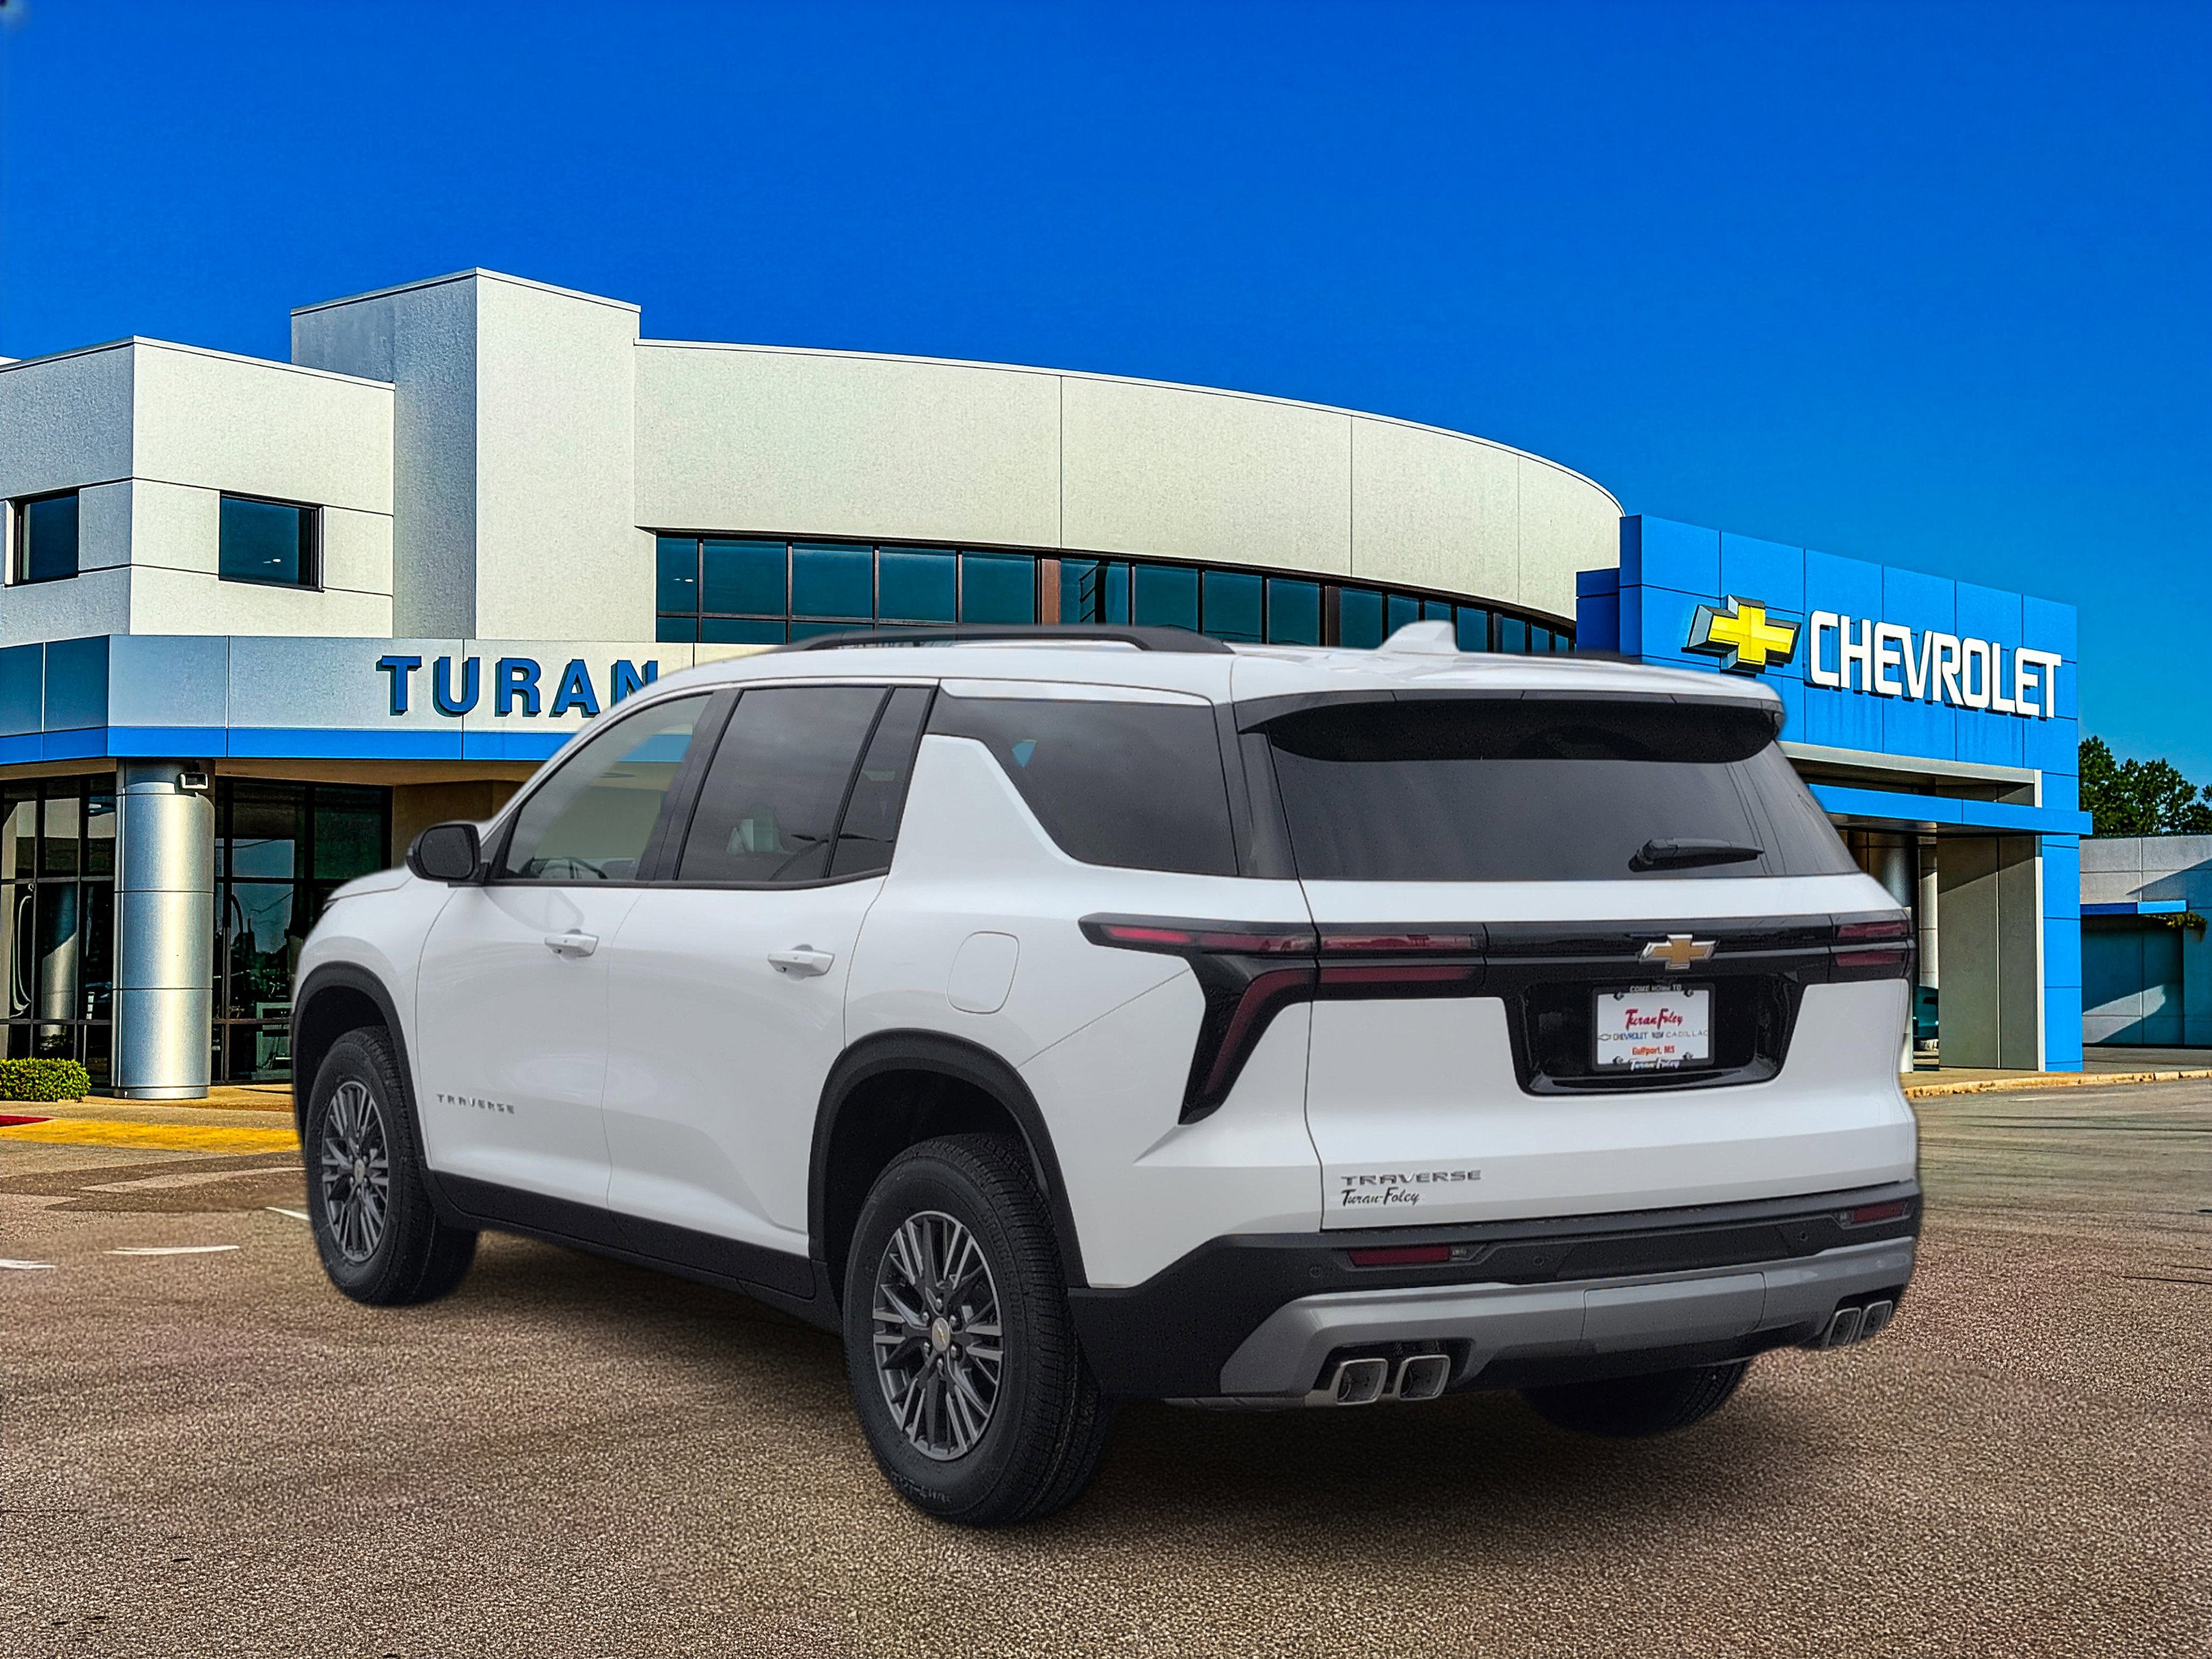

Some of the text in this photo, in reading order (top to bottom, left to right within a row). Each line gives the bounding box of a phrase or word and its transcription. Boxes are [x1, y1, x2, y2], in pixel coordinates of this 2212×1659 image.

[1810, 609, 2062, 719] CHEVROLET
[376, 655, 658, 718] TURAN
[1612, 1030, 1708, 1041] CHEVROLET CADILLAC
[436, 1094, 515, 1114] TRAVERSE
[1341, 1170, 1481, 1186] TRAVERSE
